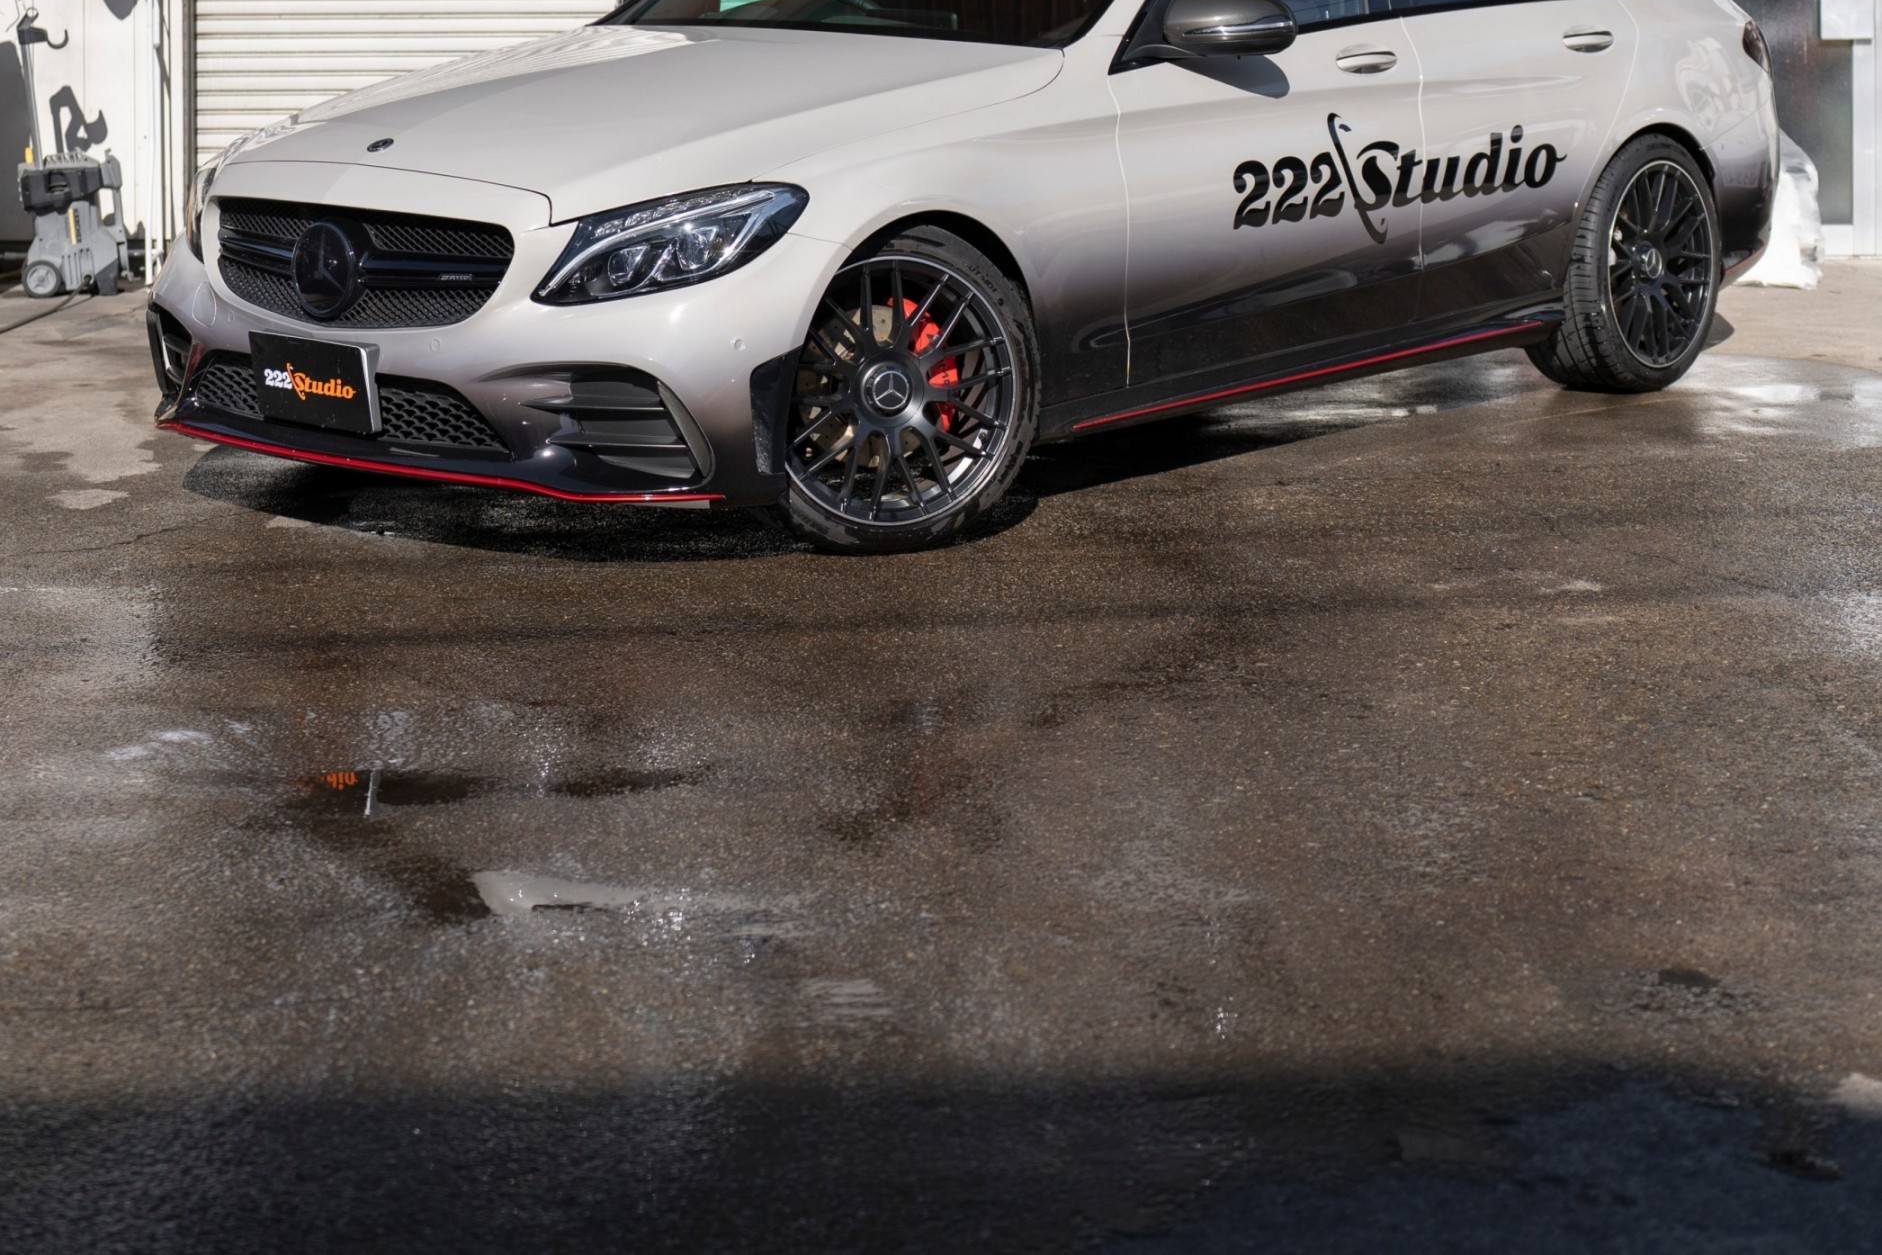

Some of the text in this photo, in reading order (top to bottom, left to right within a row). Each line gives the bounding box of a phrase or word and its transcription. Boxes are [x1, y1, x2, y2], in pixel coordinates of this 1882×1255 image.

[1233, 113, 1567, 243] 222 Studio
[264, 363, 356, 400] 222 Studio
